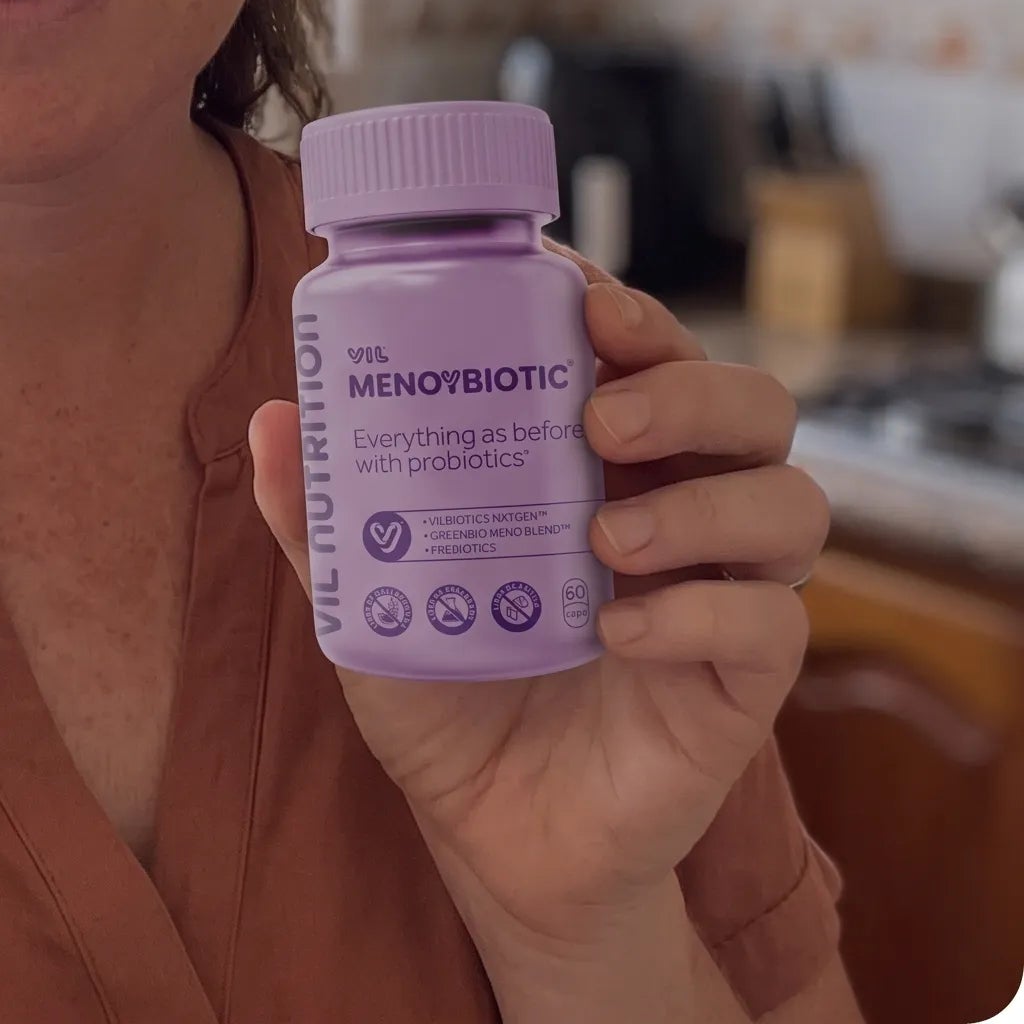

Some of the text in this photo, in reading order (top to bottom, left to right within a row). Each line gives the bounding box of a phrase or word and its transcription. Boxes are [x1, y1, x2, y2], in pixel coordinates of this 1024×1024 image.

[353, 420, 585, 453] Everything as before
[355, 452, 402, 474] with
[428, 514, 490, 526] VILBIOTICS
[429, 528, 488, 541] GREENBIO
[489, 527, 523, 539] MENO
[565, 585, 586, 600] 60
